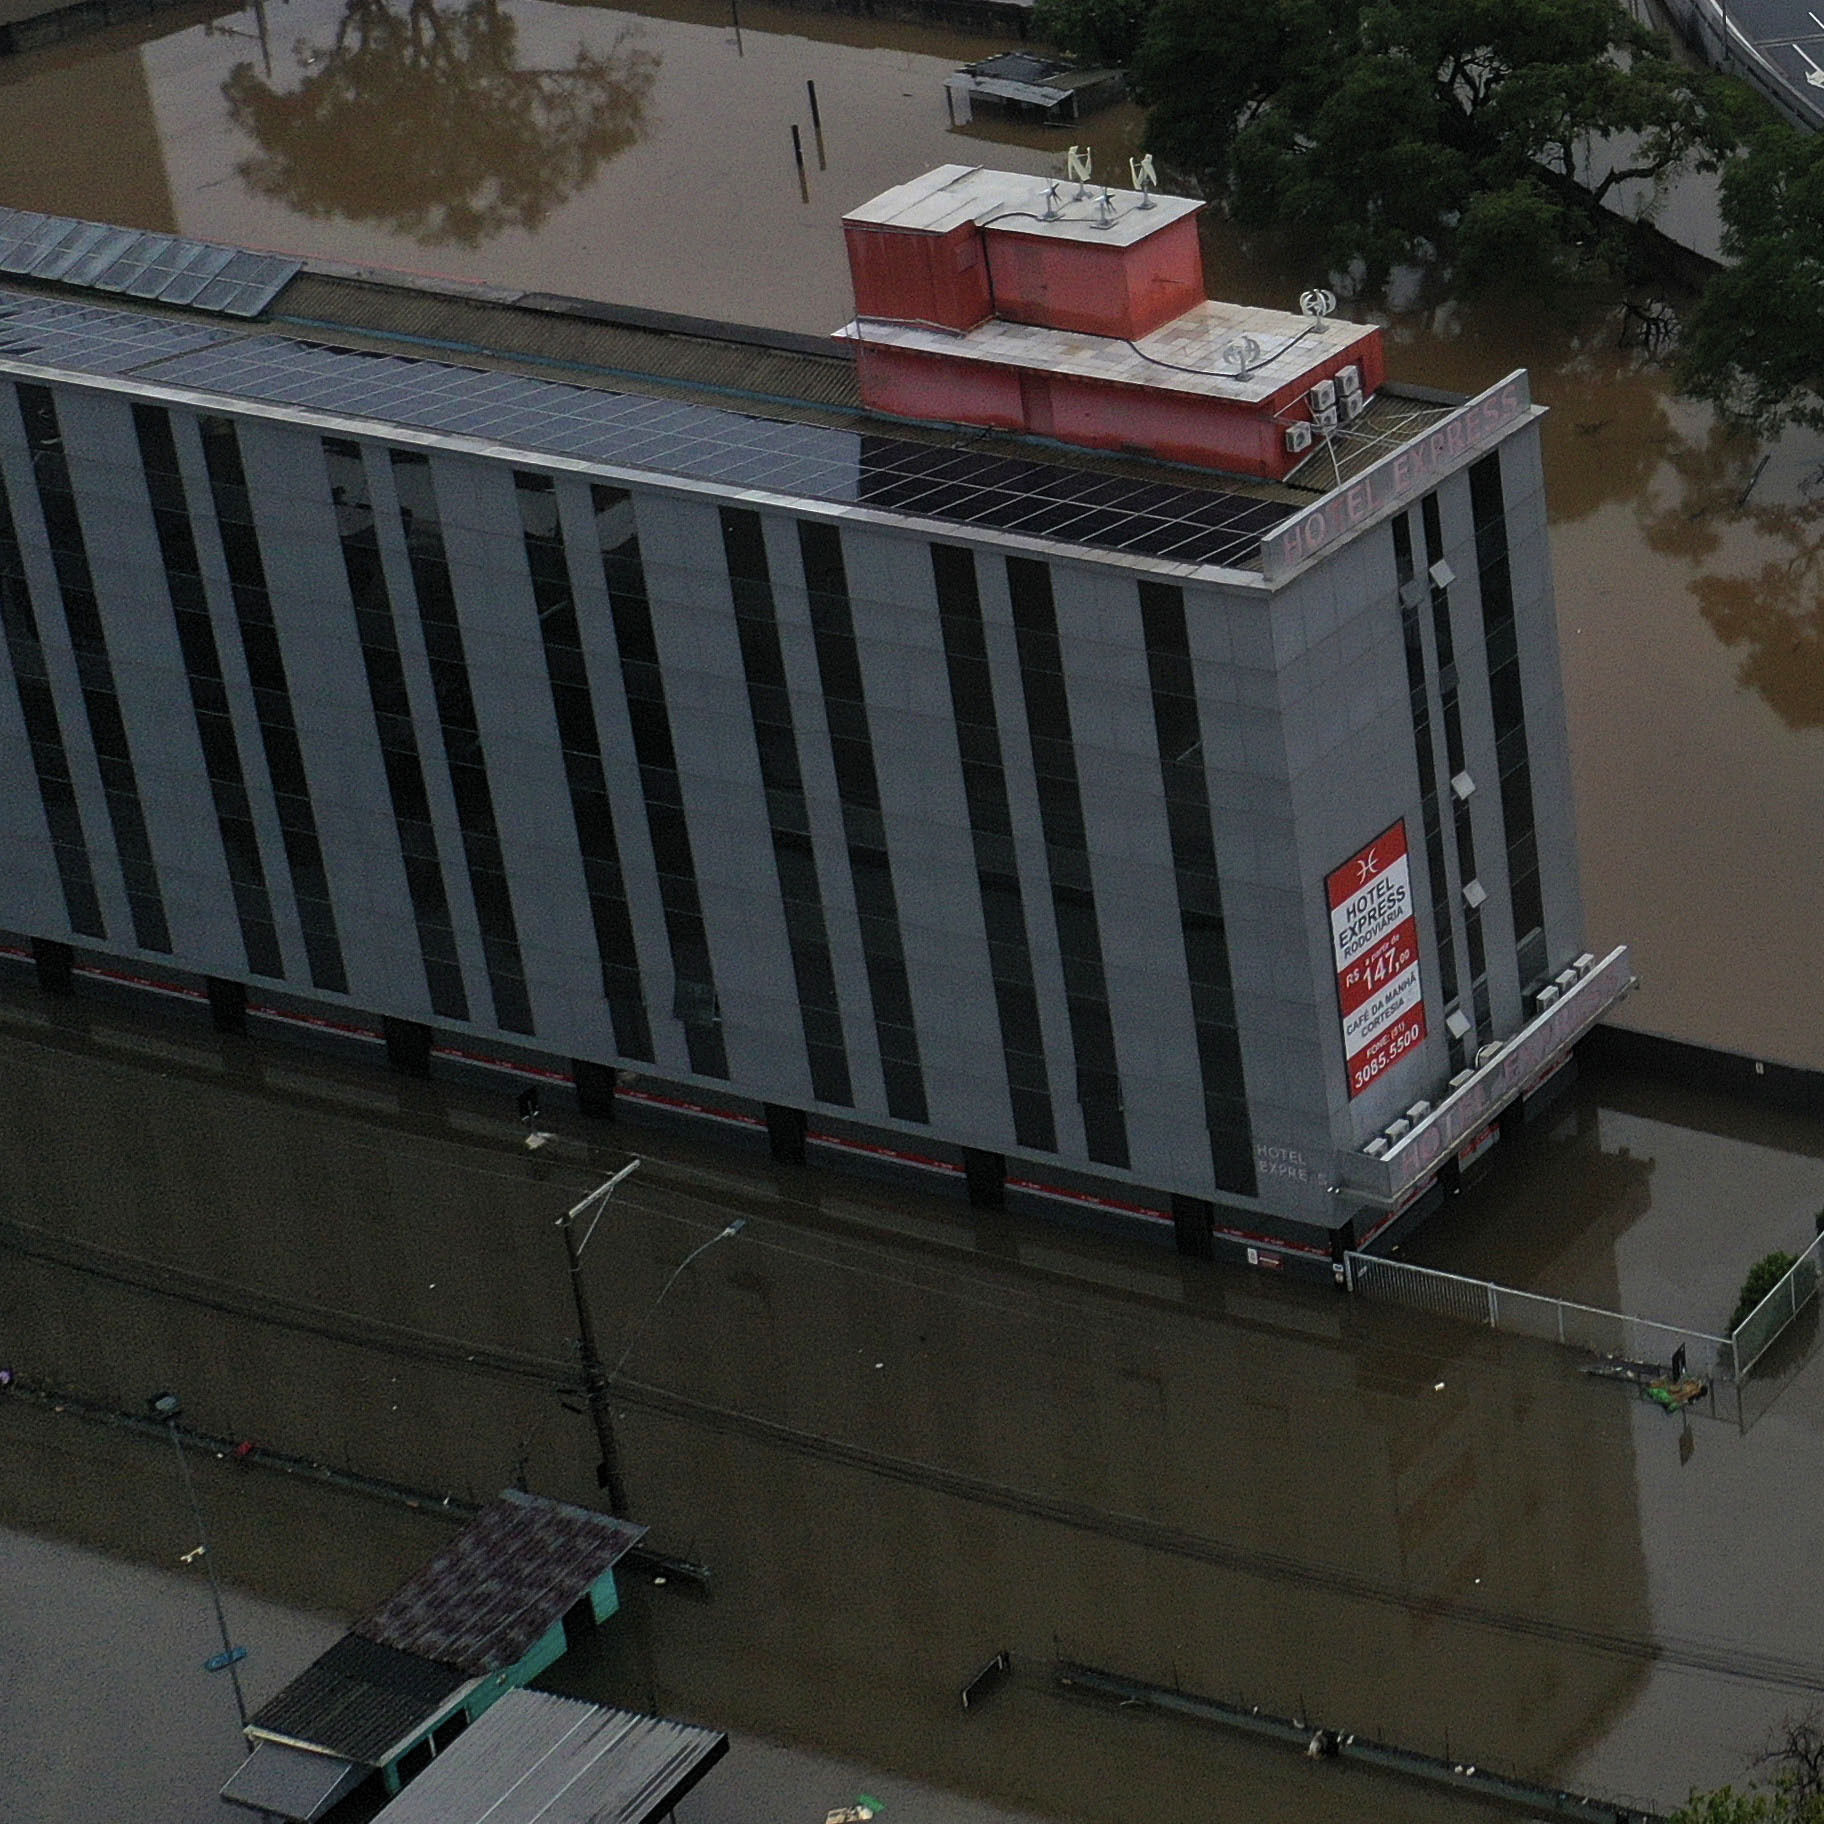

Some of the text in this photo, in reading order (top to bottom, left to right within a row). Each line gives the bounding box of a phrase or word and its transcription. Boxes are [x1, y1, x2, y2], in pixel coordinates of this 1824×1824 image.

[1283, 383, 1520, 564] HOTEL EXPRESS
[1339, 885, 1405, 949] EXPRESS
[1345, 877, 1394, 923] HOTEL
[1344, 907, 1404, 959] RODOVIÁRIA
[1363, 947, 1410, 990] 147,00
[1346, 1009, 1369, 1036] CAFÉ
[1371, 998, 1384, 1016] DA
[1361, 997, 1405, 1038] CORTESIA
[1355, 1023, 1419, 1088] 3085.5500
[1256, 1144, 1307, 1167] HOTEL
